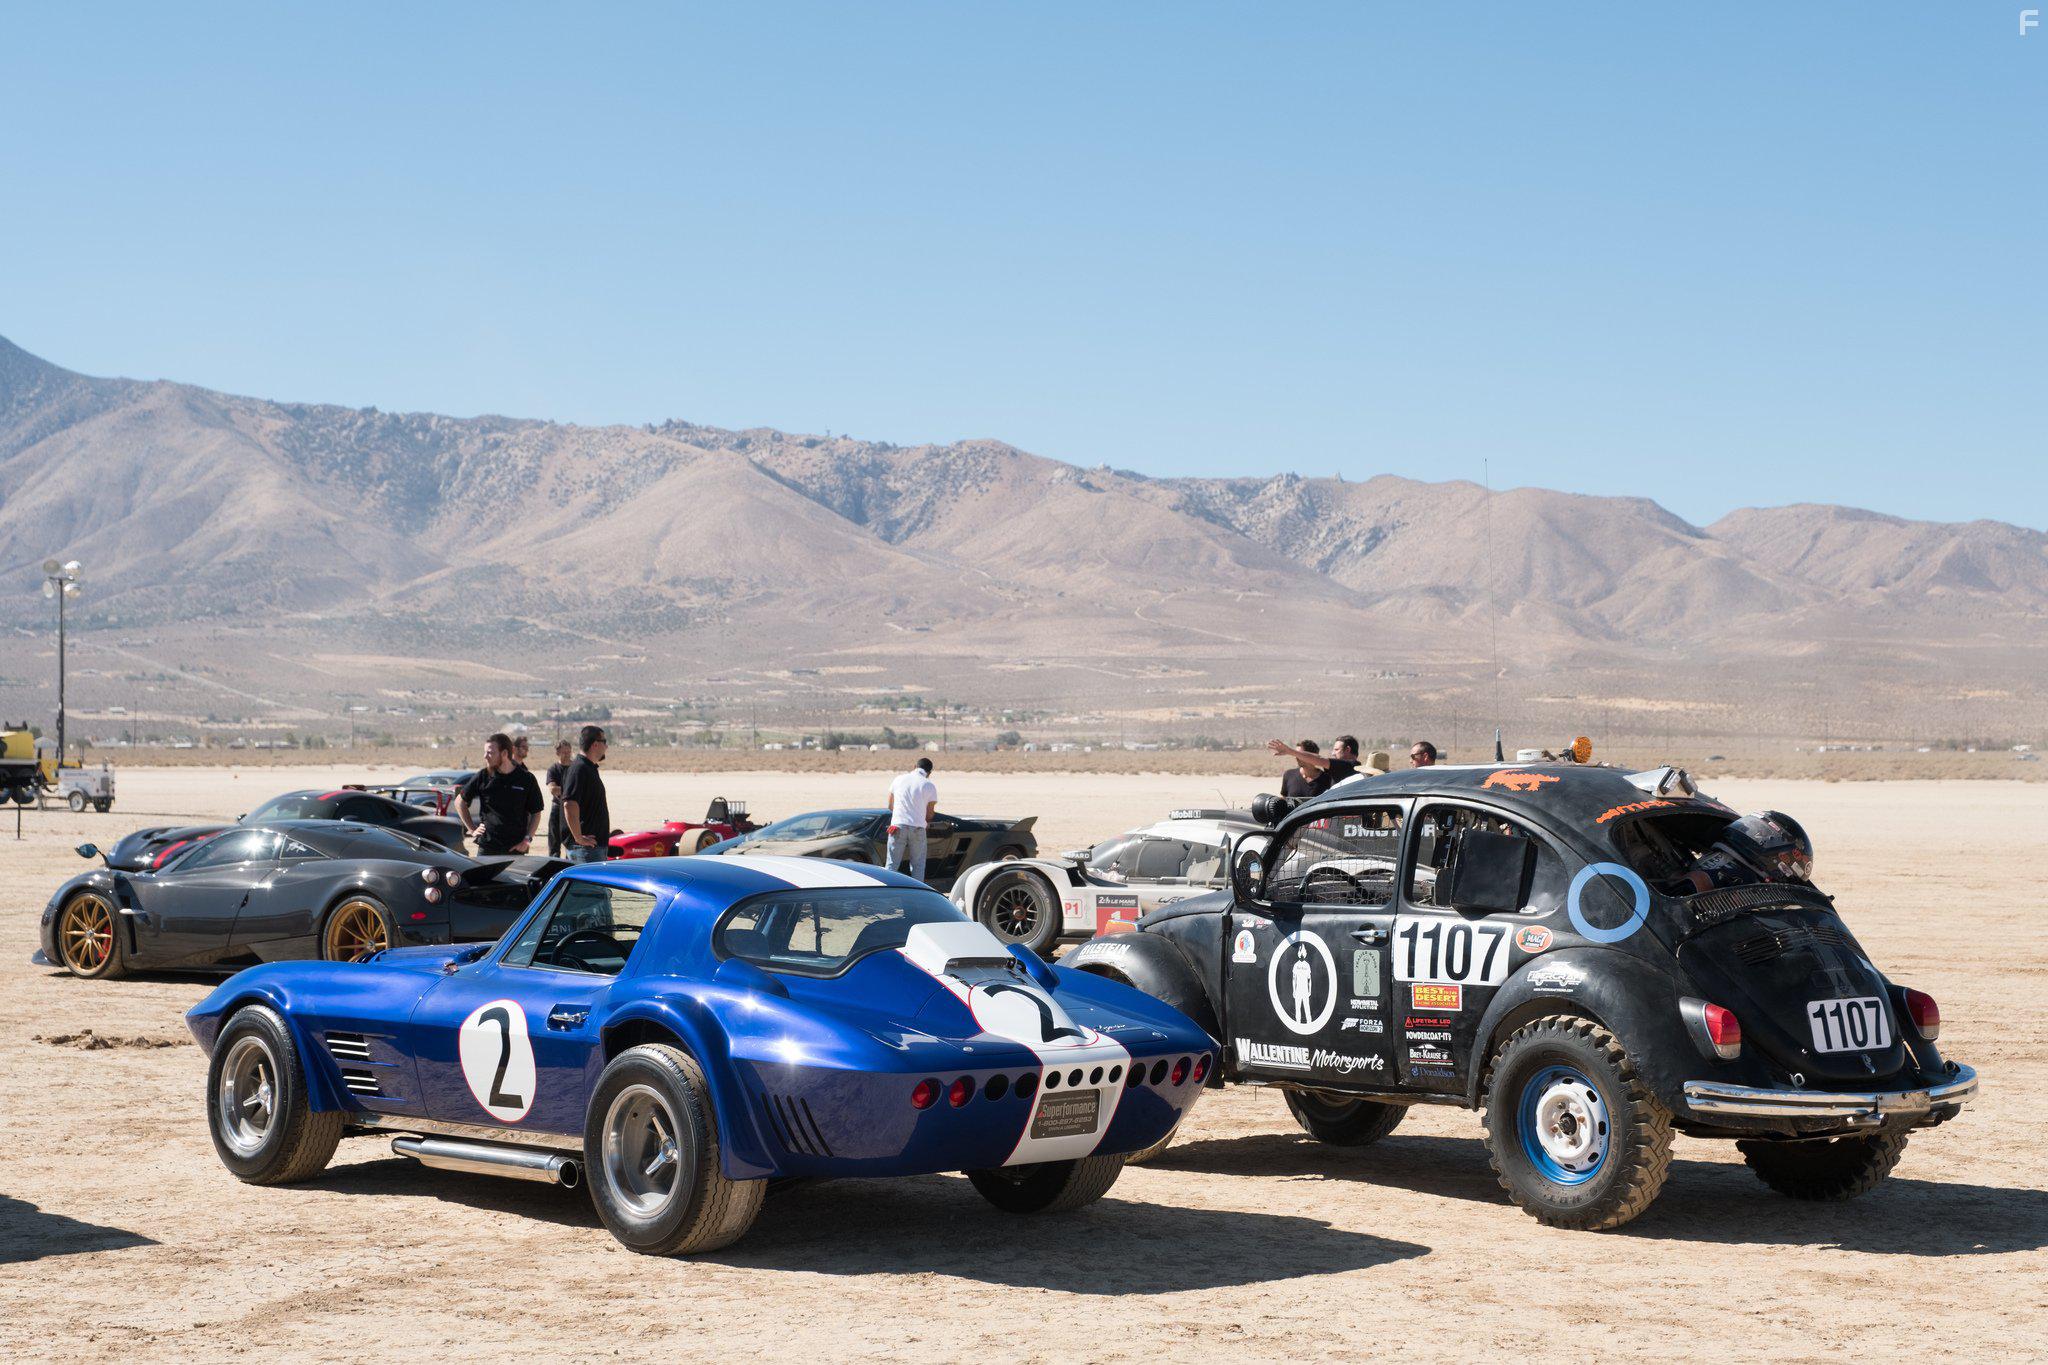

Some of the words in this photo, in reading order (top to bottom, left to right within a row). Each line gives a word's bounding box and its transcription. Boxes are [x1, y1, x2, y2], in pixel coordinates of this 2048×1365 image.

[1171, 810, 1193, 819] Mobil
[1065, 903, 1079, 915] P1
[1081, 943, 1131, 955] BILSTEIN
[1400, 922, 1507, 982] 1107
[1416, 986, 1444, 995] BEST
[983, 984, 1088, 1043] 2
[1813, 1000, 1882, 1050] 1107
[478, 1007, 523, 1109] 2
[1235, 1038, 1311, 1066] WALLENTINE
[1311, 1049, 1385, 1075] Motorsports
[1043, 1102, 1096, 1119] Superformance
